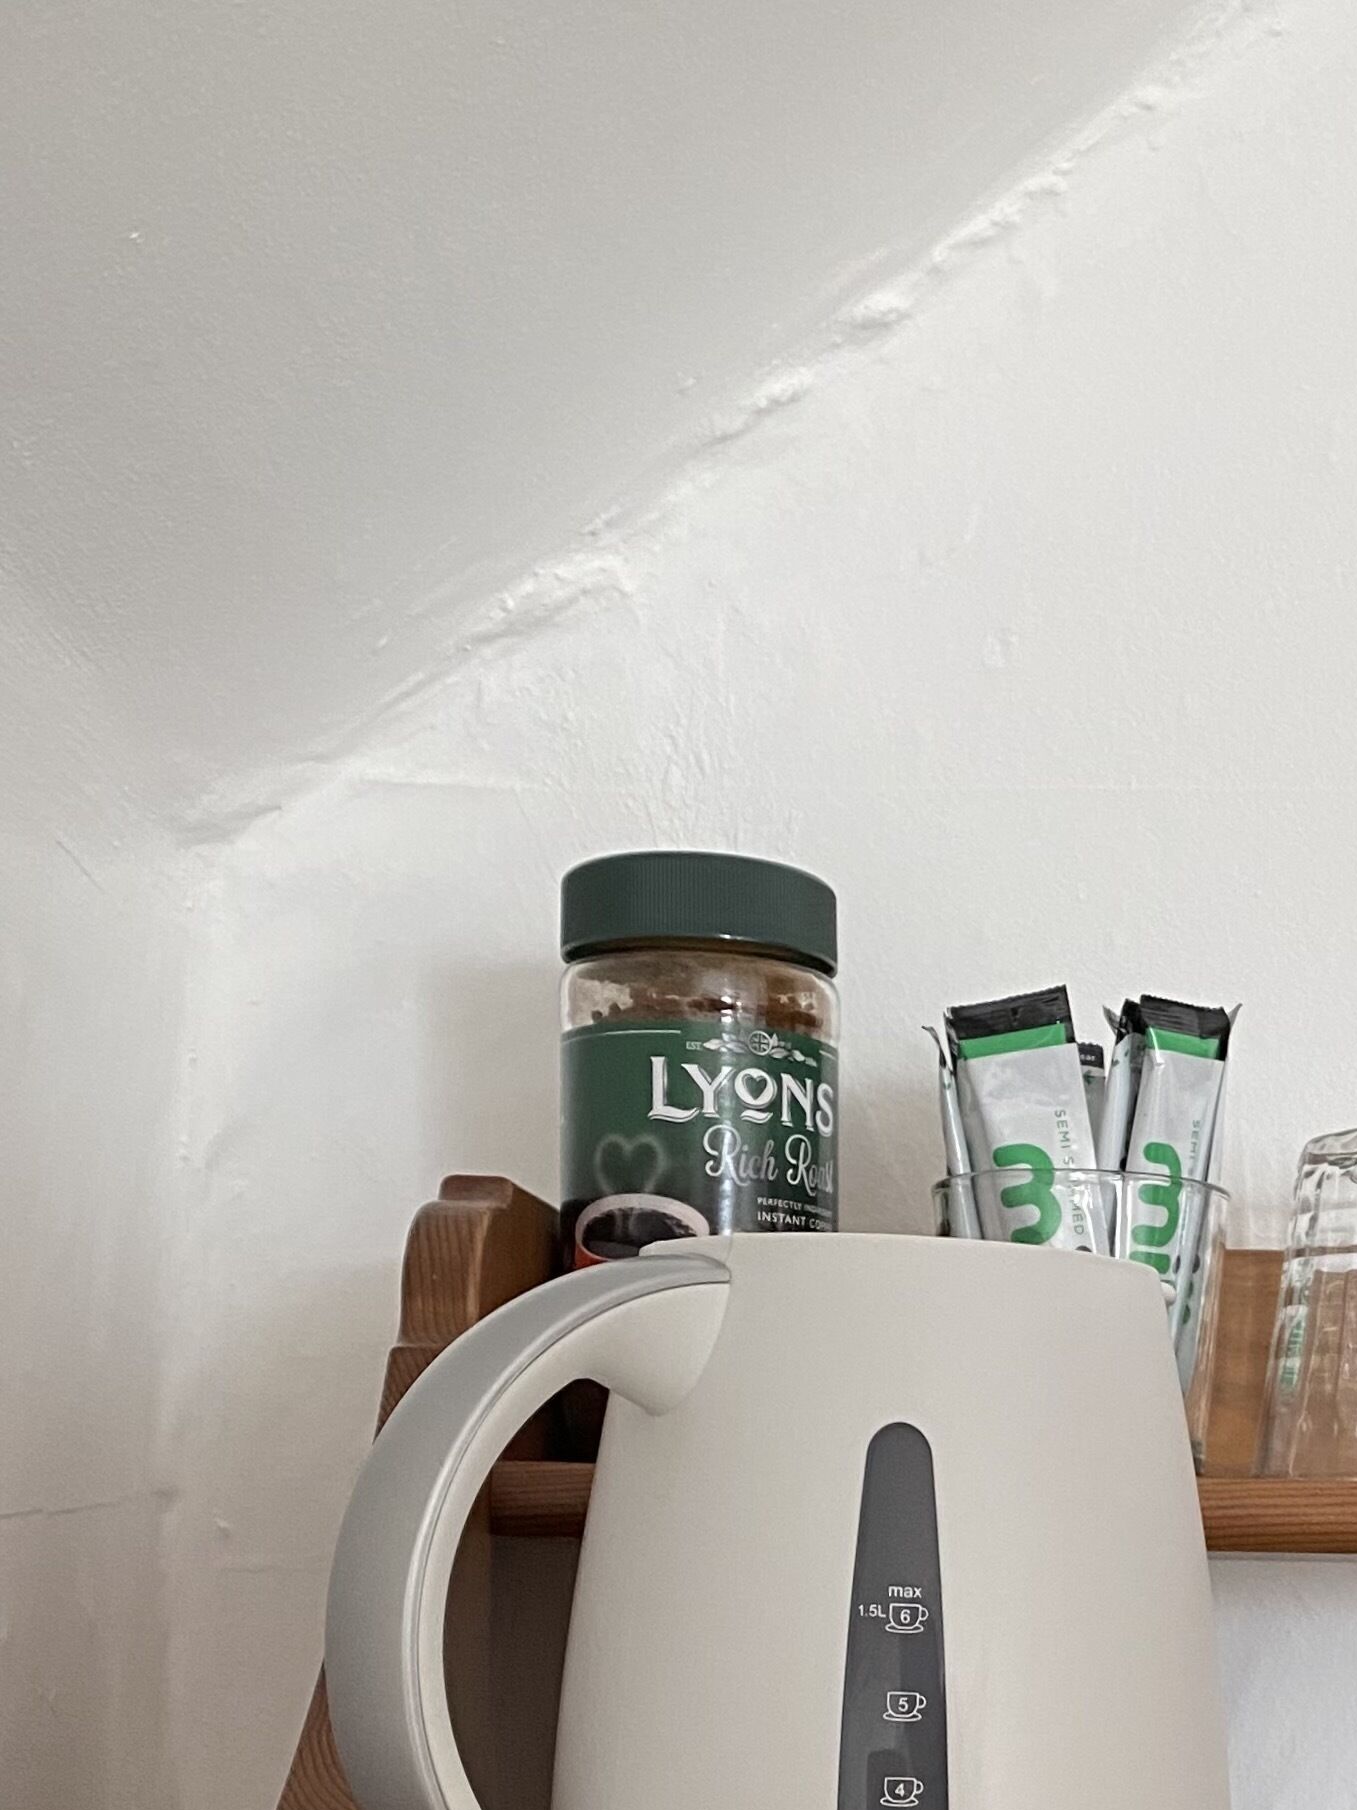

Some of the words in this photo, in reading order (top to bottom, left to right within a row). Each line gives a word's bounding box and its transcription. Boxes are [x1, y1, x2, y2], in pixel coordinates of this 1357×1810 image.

[647, 1055, 834, 1137] LYONS
[1054, 1109, 1071, 1149] SEMI
[703, 1124, 779, 1187] Rich
[757, 1211, 807, 1227] INSTANT
[888, 1585, 922, 1599] max
[858, 1603, 887, 1618] 1.5L
[900, 1608, 911, 1624] 6
[898, 1696, 909, 1713] 5
[894, 1783, 906, 1797] 4
